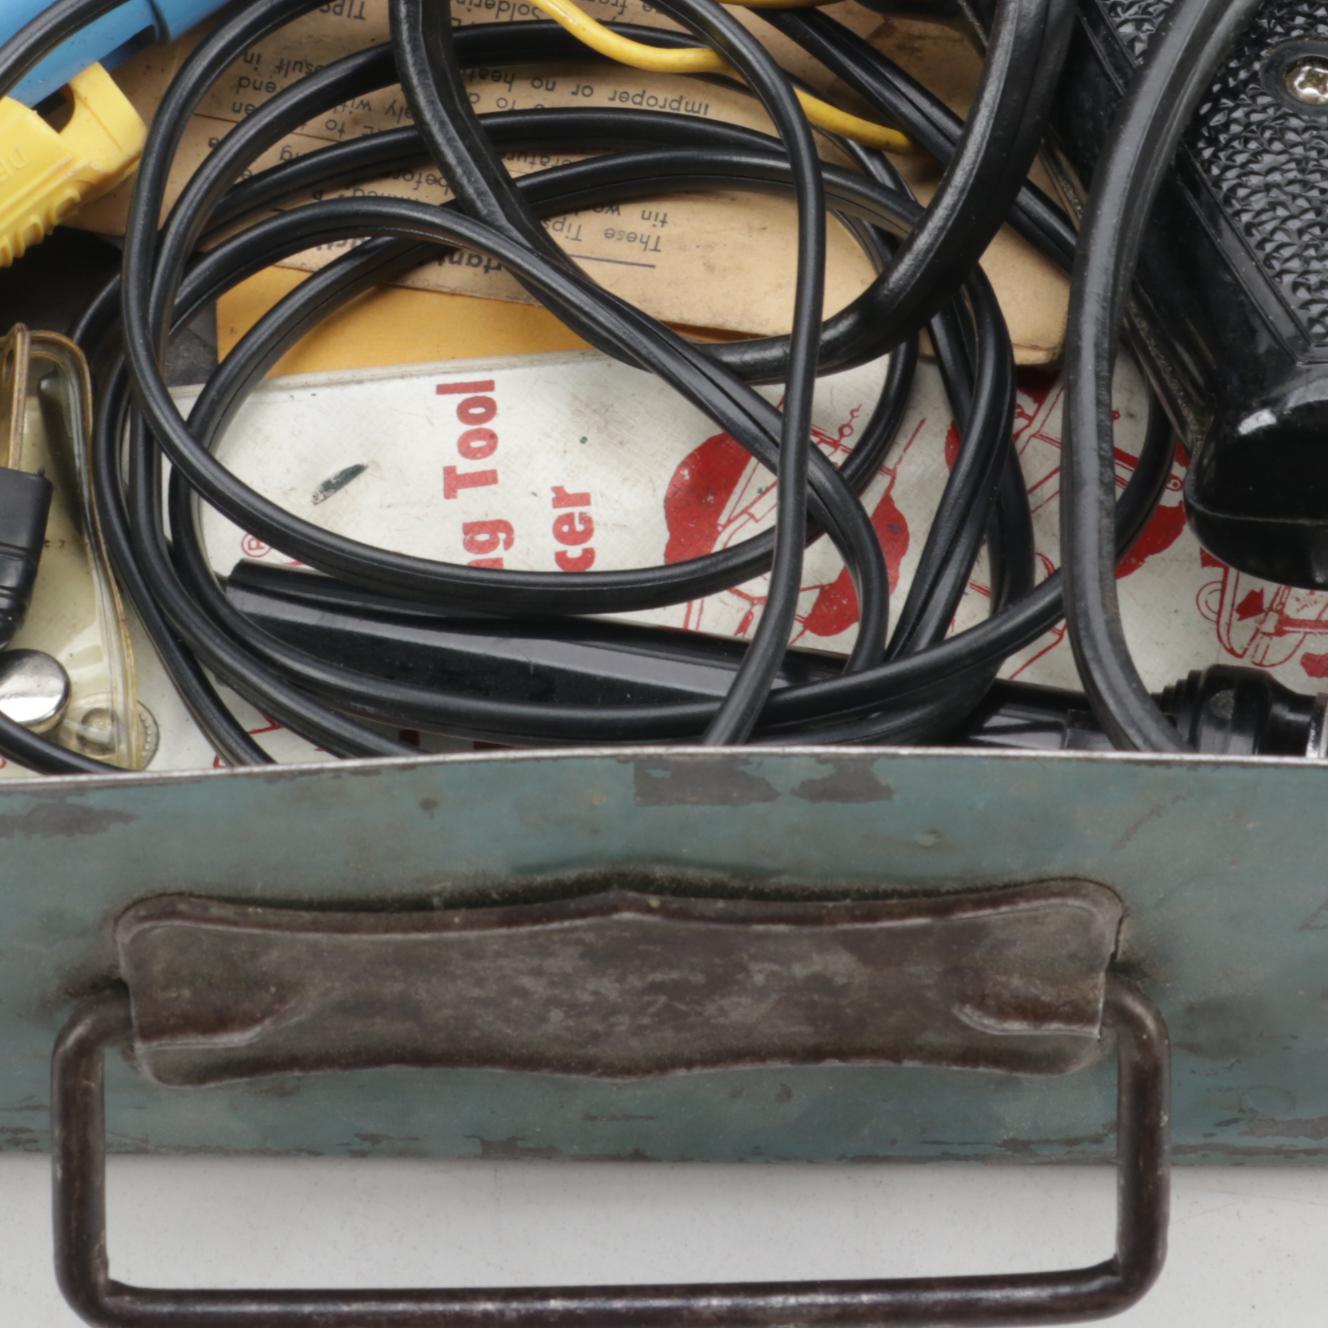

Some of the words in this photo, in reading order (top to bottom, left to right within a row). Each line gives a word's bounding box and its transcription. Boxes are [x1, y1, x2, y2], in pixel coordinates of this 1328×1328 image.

[530, 75, 558, 93] no
[571, 81, 595, 98] or
[608, 84, 710, 116] improper
[324, 118, 347, 139] to
[640, 208, 670, 230] tin
[603, 226, 663, 254] These
[435, 379, 499, 500] Tool
